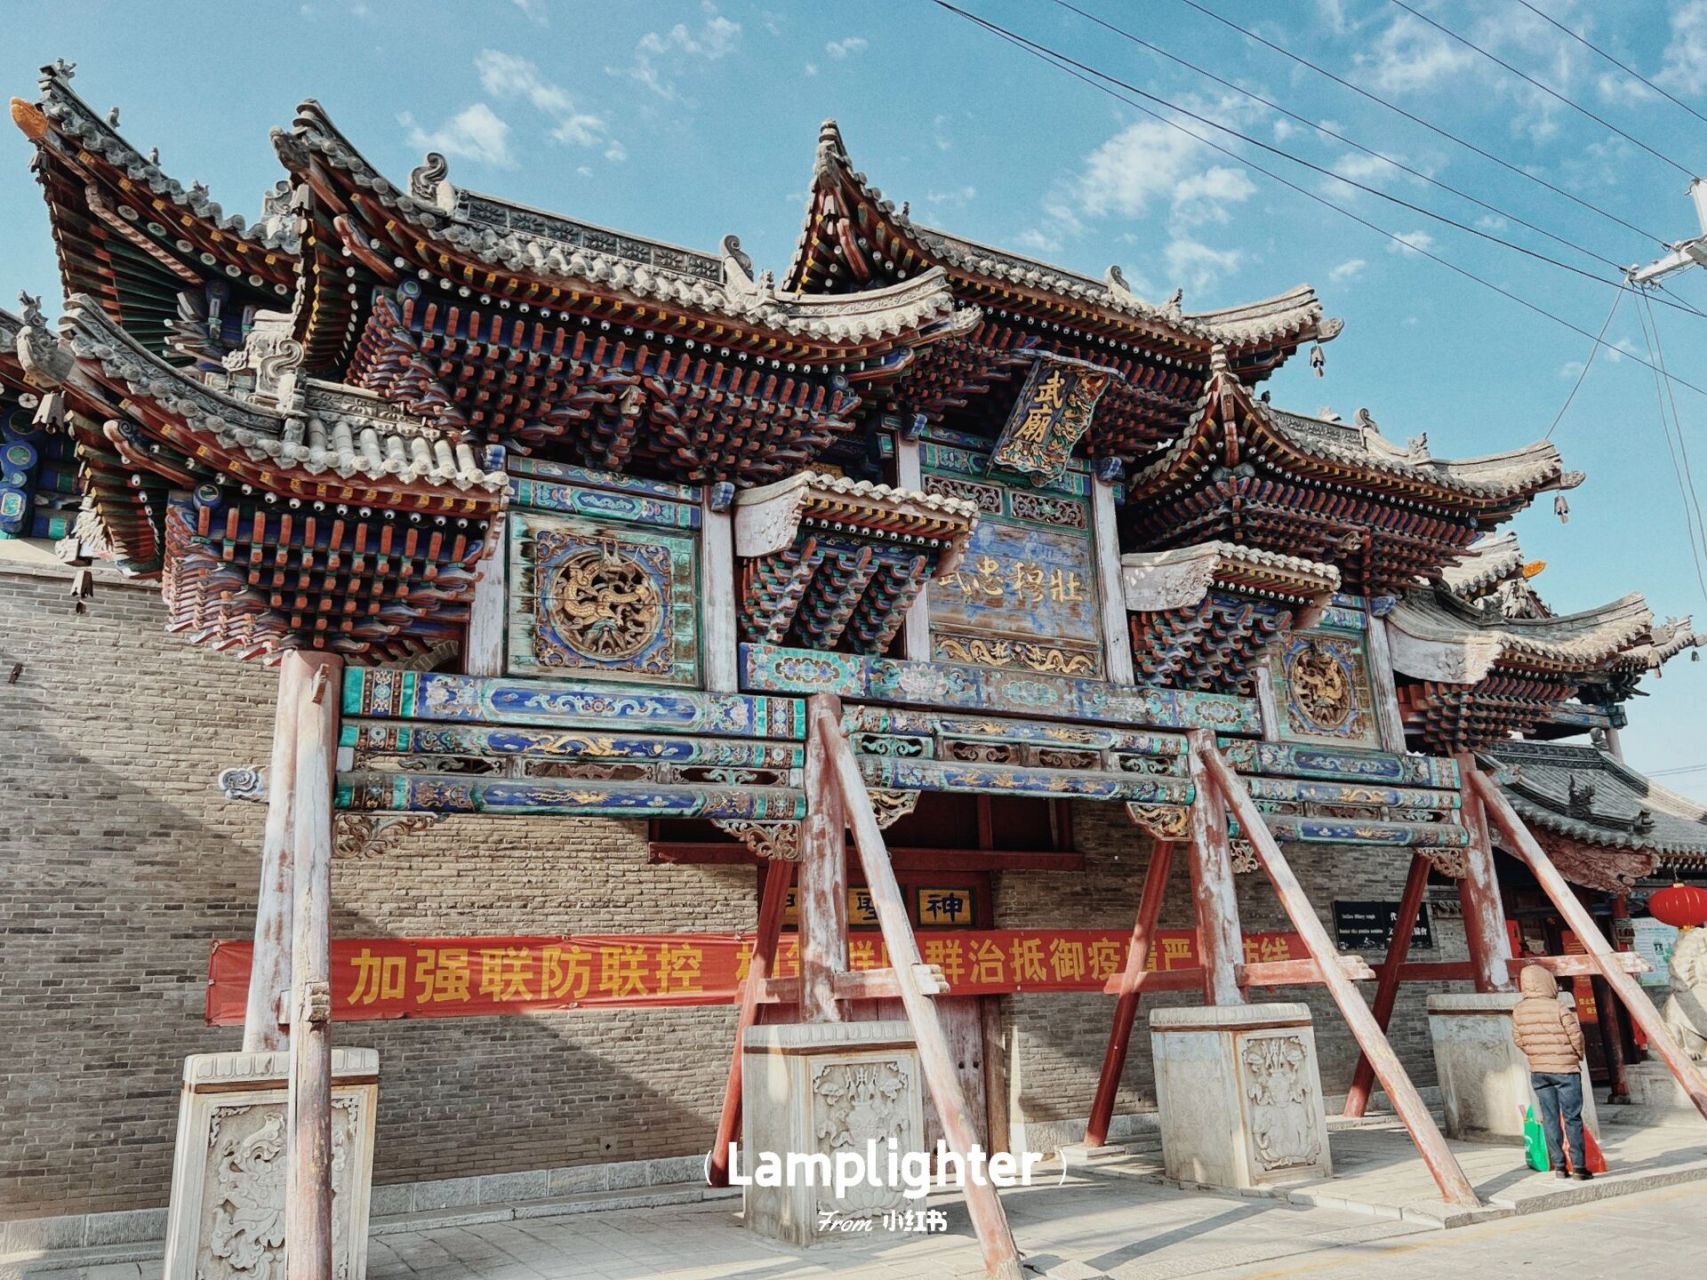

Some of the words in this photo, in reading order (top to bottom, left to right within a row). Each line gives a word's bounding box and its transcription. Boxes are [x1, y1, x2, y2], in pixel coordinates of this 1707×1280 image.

[1013, 369, 1066, 444] 武廟
[347, 942, 704, 1006] 加强联防联控
